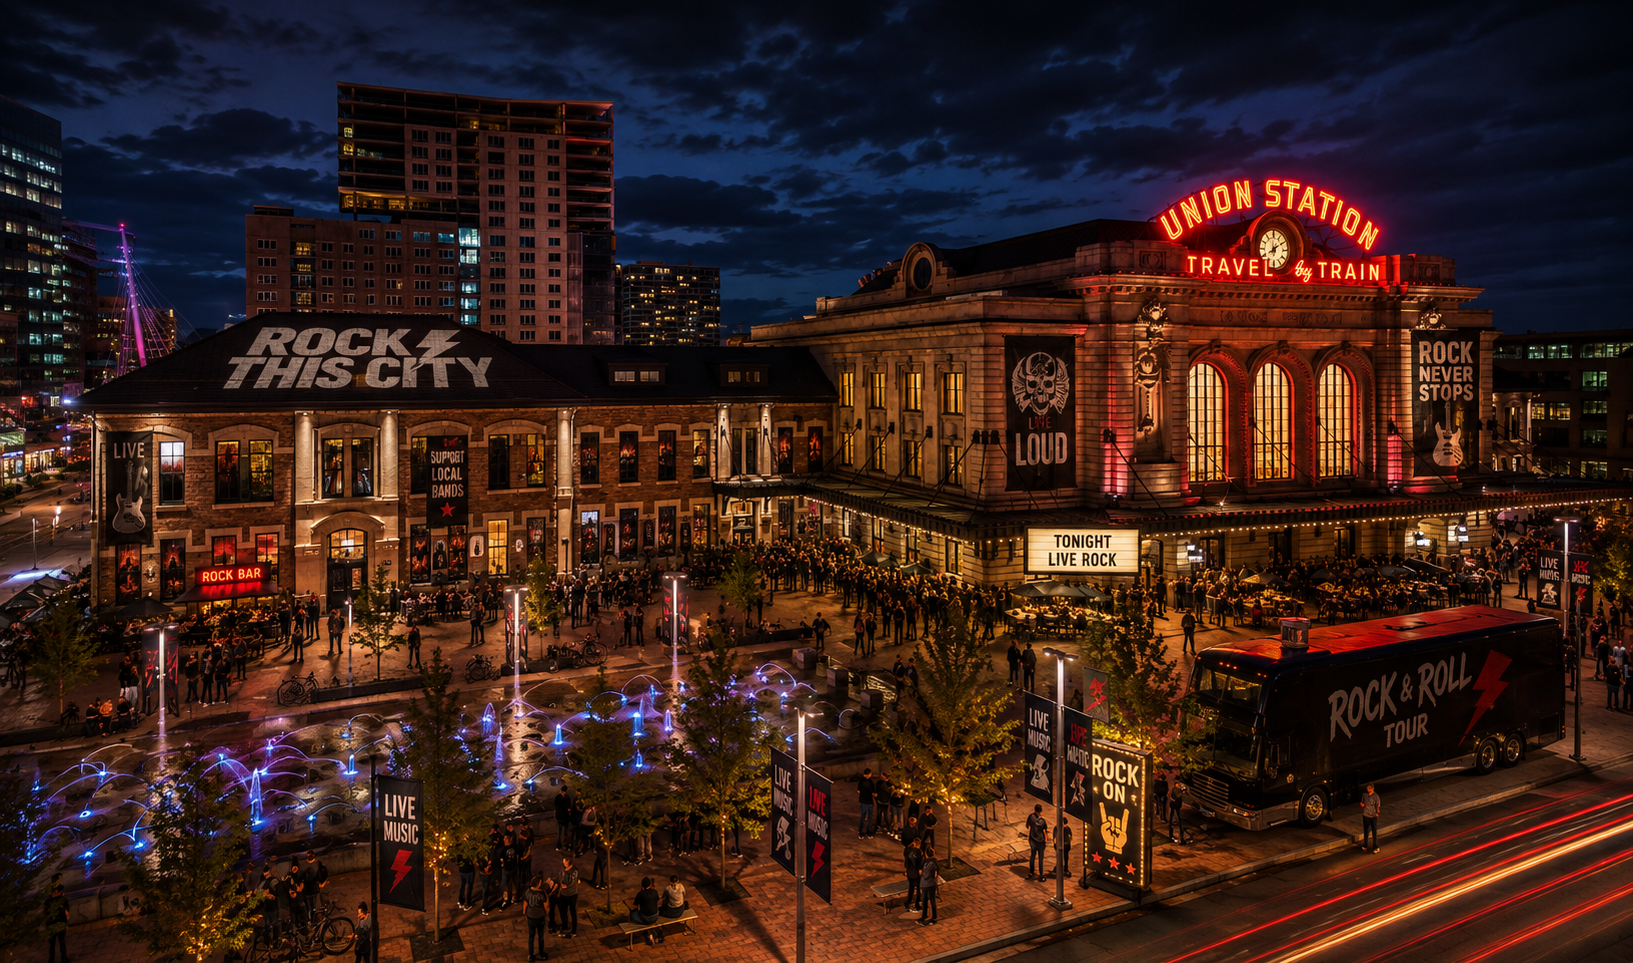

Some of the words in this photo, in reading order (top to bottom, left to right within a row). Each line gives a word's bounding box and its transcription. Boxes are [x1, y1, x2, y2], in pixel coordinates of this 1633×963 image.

[1160, 180, 1252, 240] UNION
[1265, 179, 1379, 250] STATION
[1187, 256, 1273, 277] TRAVEL
[1294, 260, 1312, 283] by
[1318, 262, 1380, 281] TRAIN
[245, 327, 412, 356] ROCK
[1418, 340, 1474, 364] ROCK
[223, 356, 354, 389] THIS
[365, 356, 493, 388] CITY
[1418, 366, 1474, 382] NEVER
[1418, 384, 1474, 402] STOPS
[113, 442, 145, 459] LIVE
[1015, 431, 1068, 466] LOUD
[431, 466, 463, 481] LOCAL
[1053, 534, 1112, 549] TONIGHT
[1048, 552, 1077, 567] LIVE
[1082, 552, 1117, 567] ROCK
[1540, 556, 1559, 570] LIVE
[202, 569, 233, 582] ROCK
[238, 567, 261, 580] BAR
[1327, 671, 1398, 743] ROCK
[1400, 673, 1414, 703] &
[1417, 651, 1472, 708] ROLL
[1029, 707, 1049, 731] LIVE
[1383, 712, 1429, 748] TOUR
[774, 764, 792, 793] LIVE
[1092, 753, 1139, 788] ROCK
[808, 785, 827, 816] LIVE
[1102, 780, 1125, 804] ON
[384, 793, 416, 820] LIVE
[383, 820, 419, 845] MUSIC
